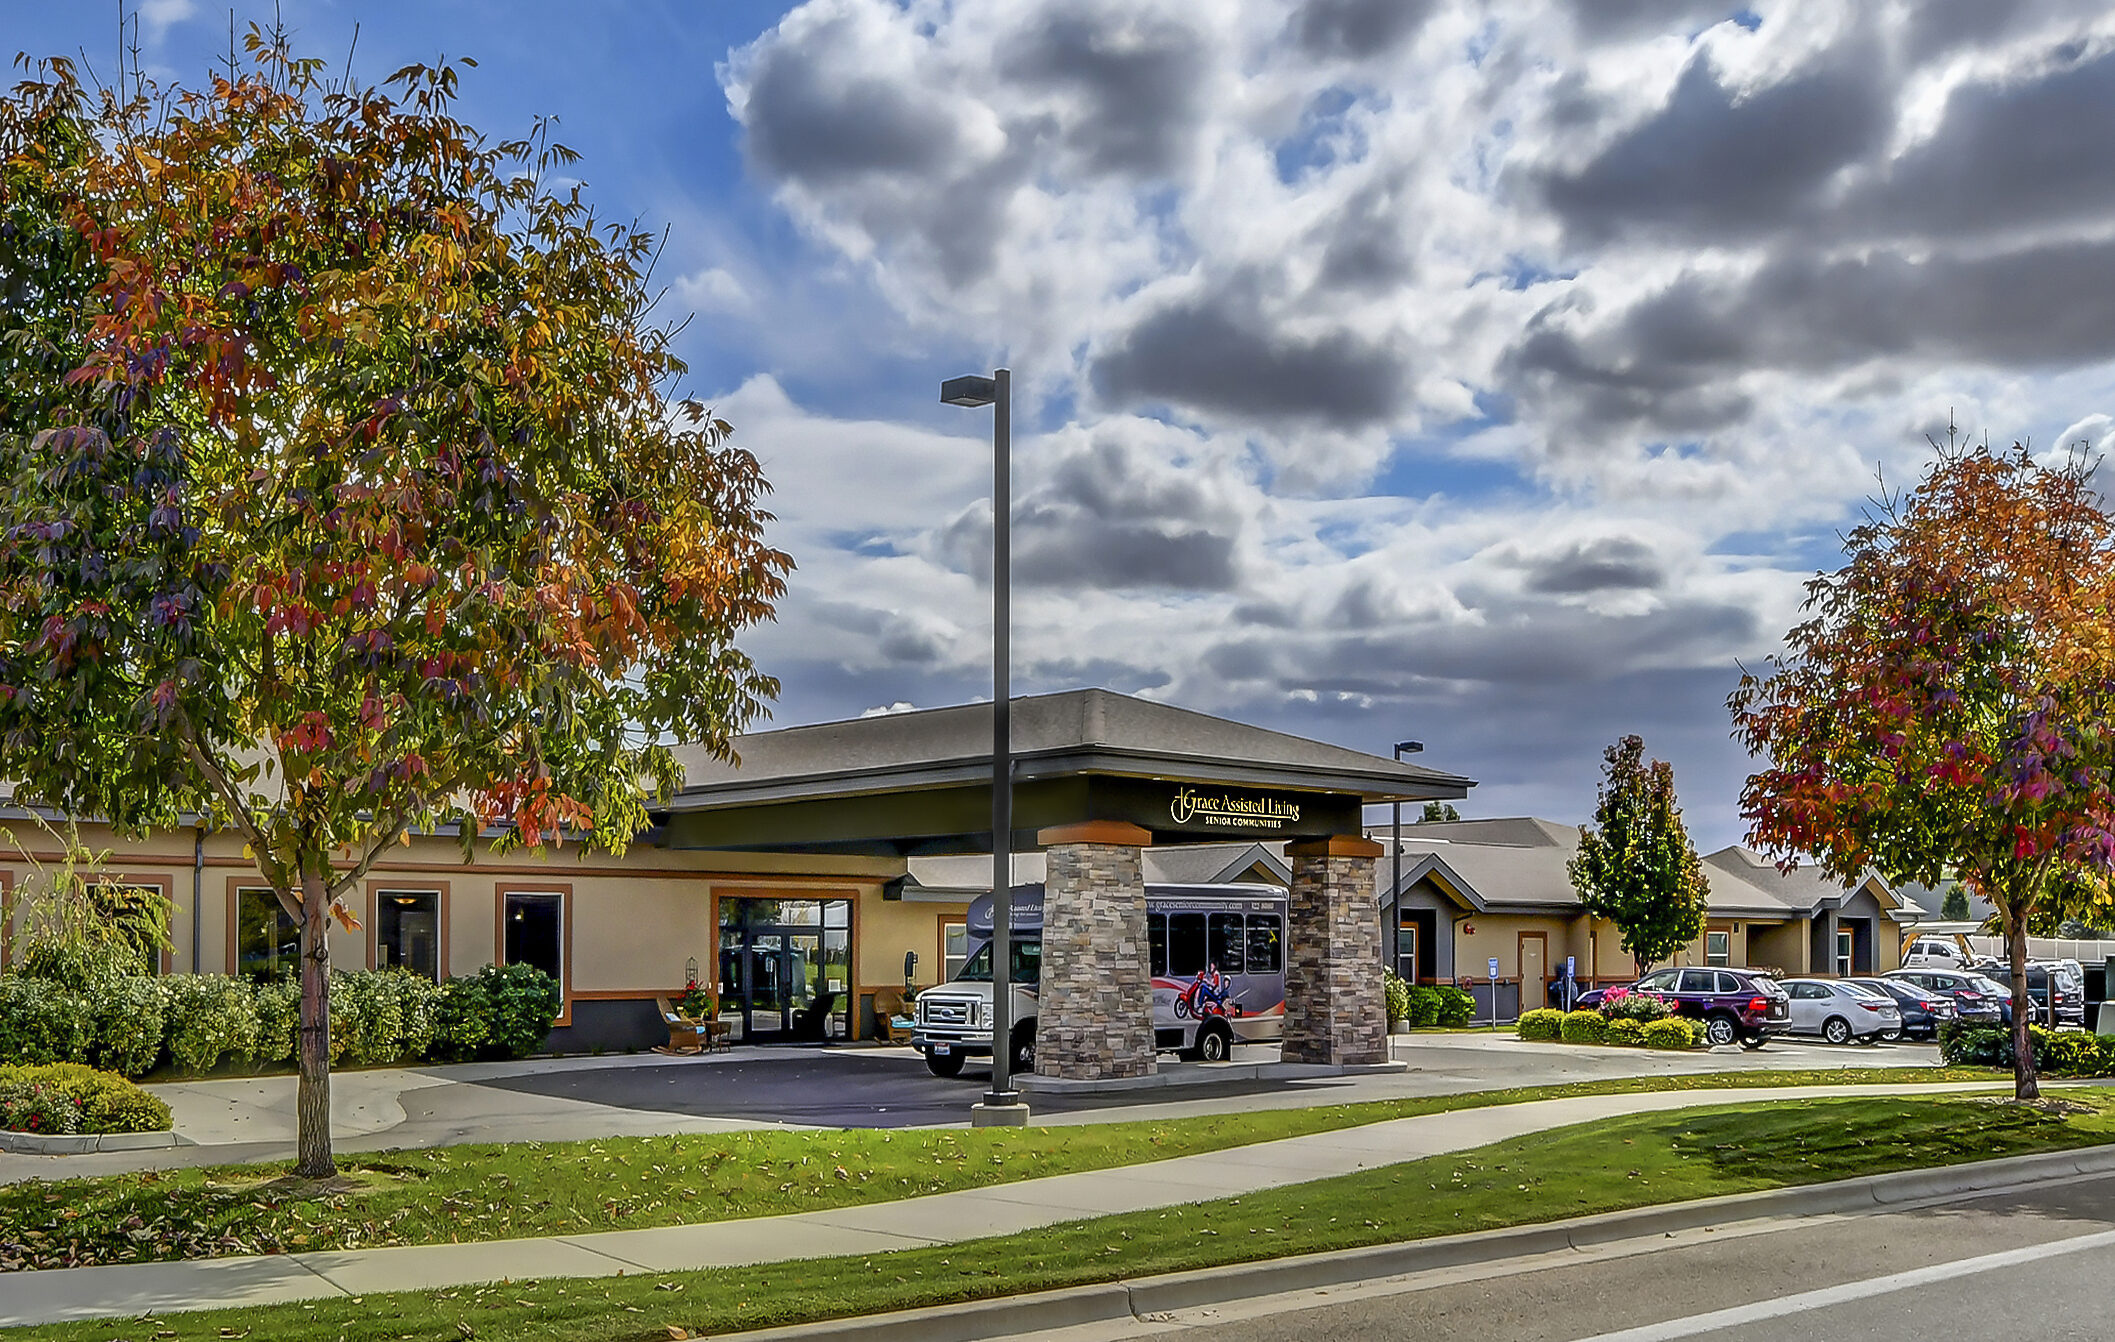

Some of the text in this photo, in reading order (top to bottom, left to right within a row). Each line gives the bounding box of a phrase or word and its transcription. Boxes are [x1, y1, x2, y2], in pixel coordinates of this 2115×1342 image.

[1221, 795, 1265, 814] Assisted
[1268, 798, 1300, 821] Living
[1205, 816, 1282, 829] SENIOR COMMUNITIES
